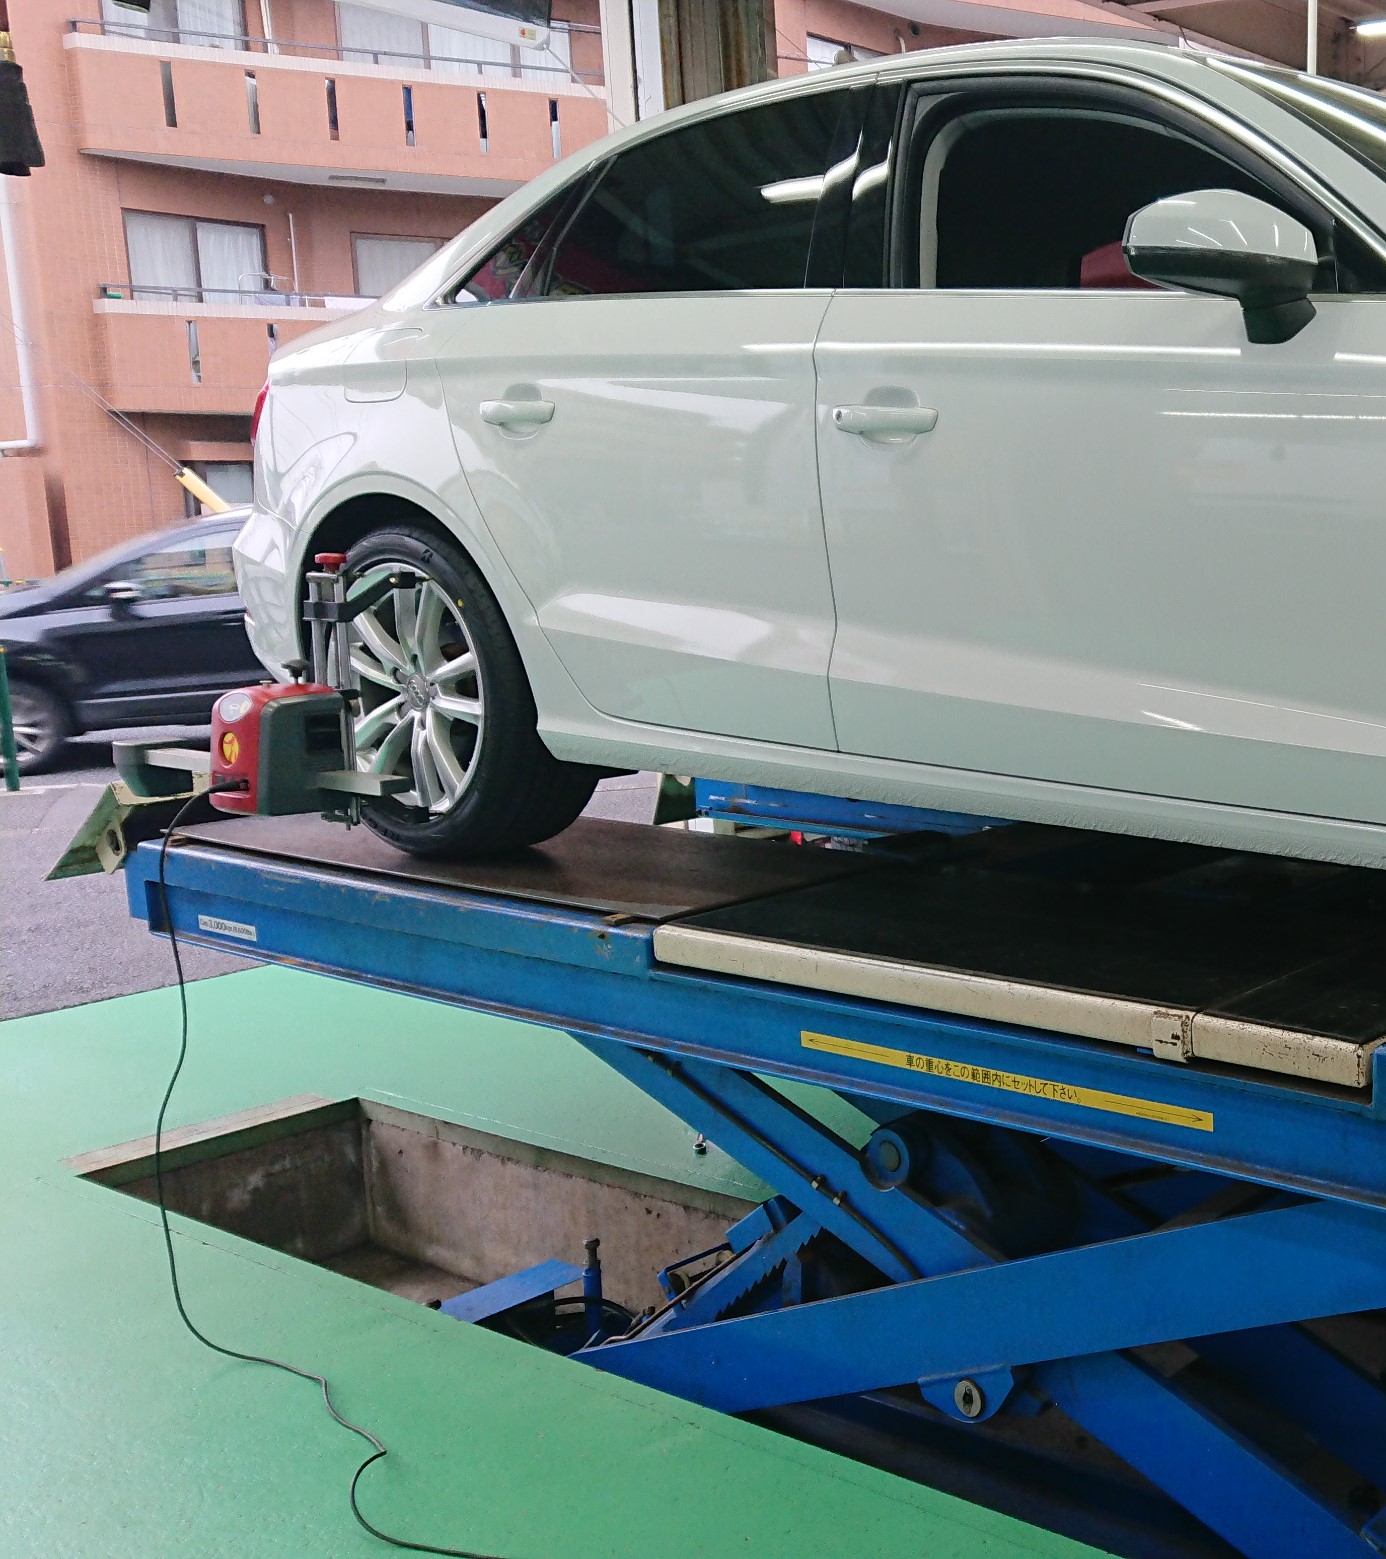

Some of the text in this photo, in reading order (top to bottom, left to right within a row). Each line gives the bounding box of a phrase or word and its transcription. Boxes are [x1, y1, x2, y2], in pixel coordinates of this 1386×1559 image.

[905, 1053, 1082, 1104] 車の重心をこの範囲内にセットして下さい。
